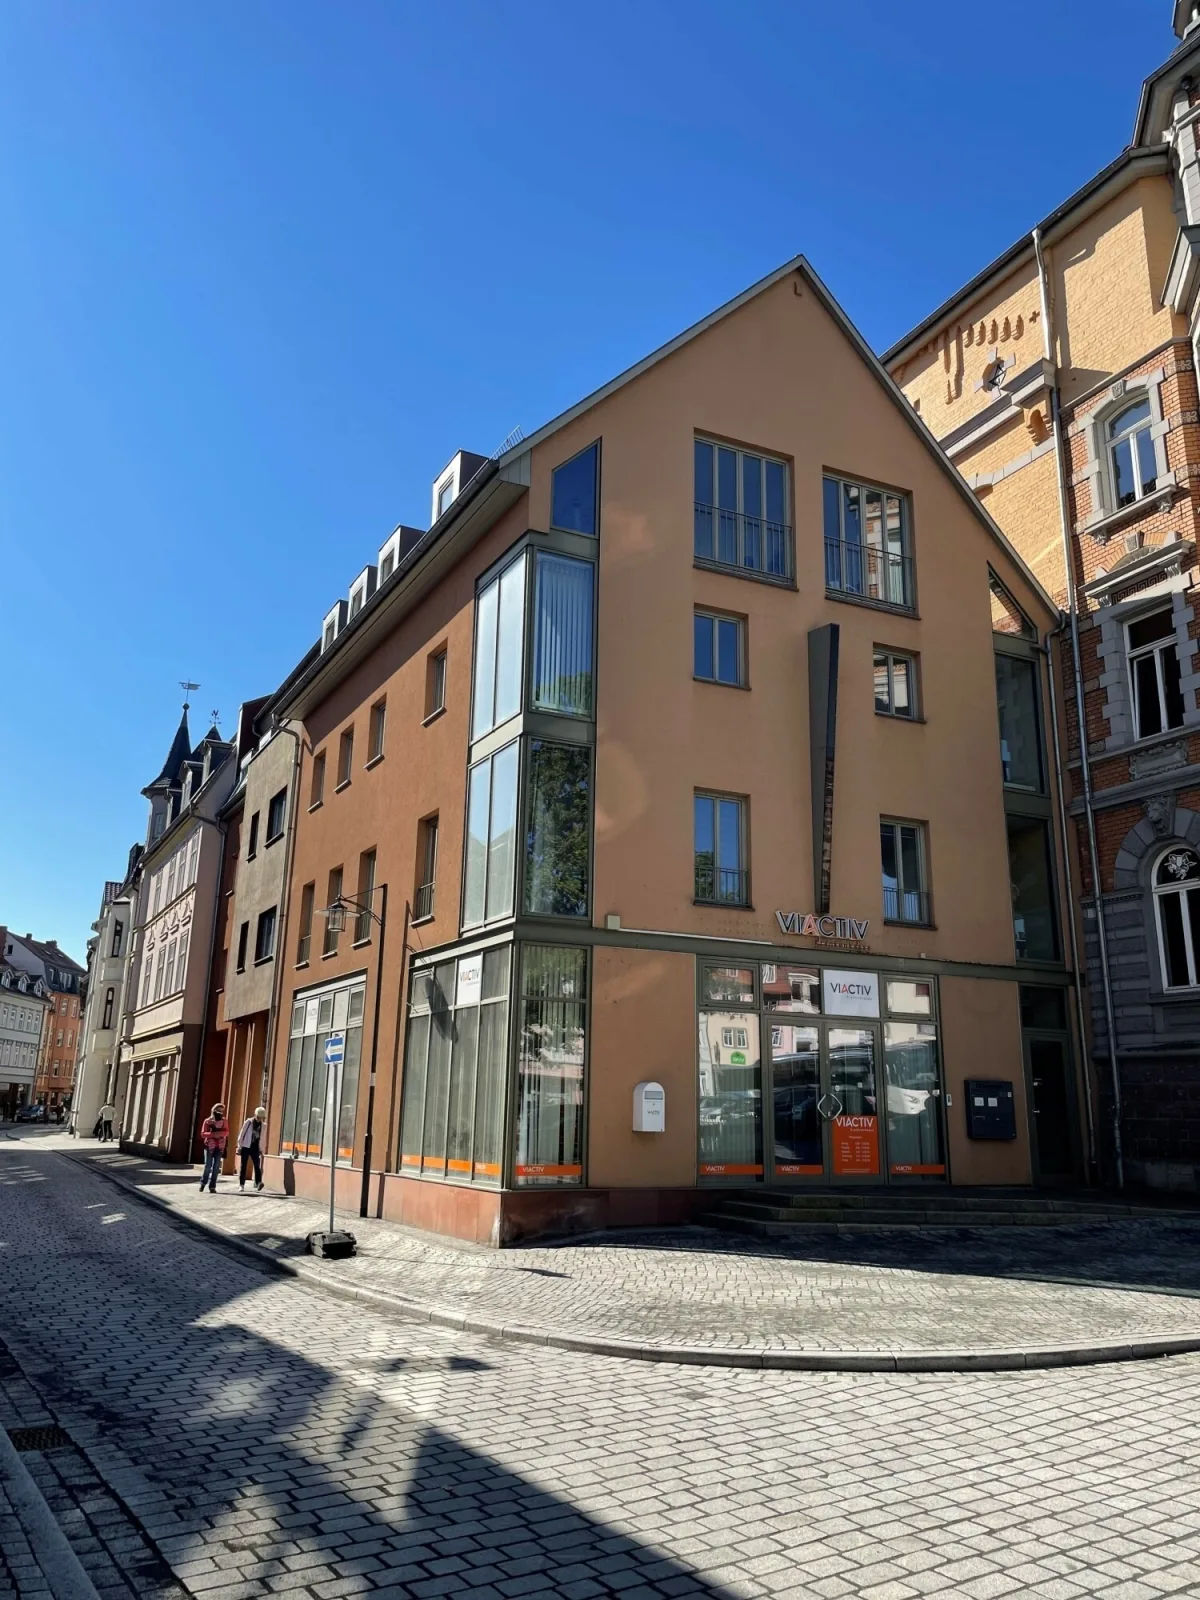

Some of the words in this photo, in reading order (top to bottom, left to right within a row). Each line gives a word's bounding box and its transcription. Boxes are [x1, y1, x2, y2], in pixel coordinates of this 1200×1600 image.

[775, 910, 870, 941] VIACTIV
[830, 982, 872, 996] VIACTIV
[836, 1116, 874, 1128] VIACTIV
